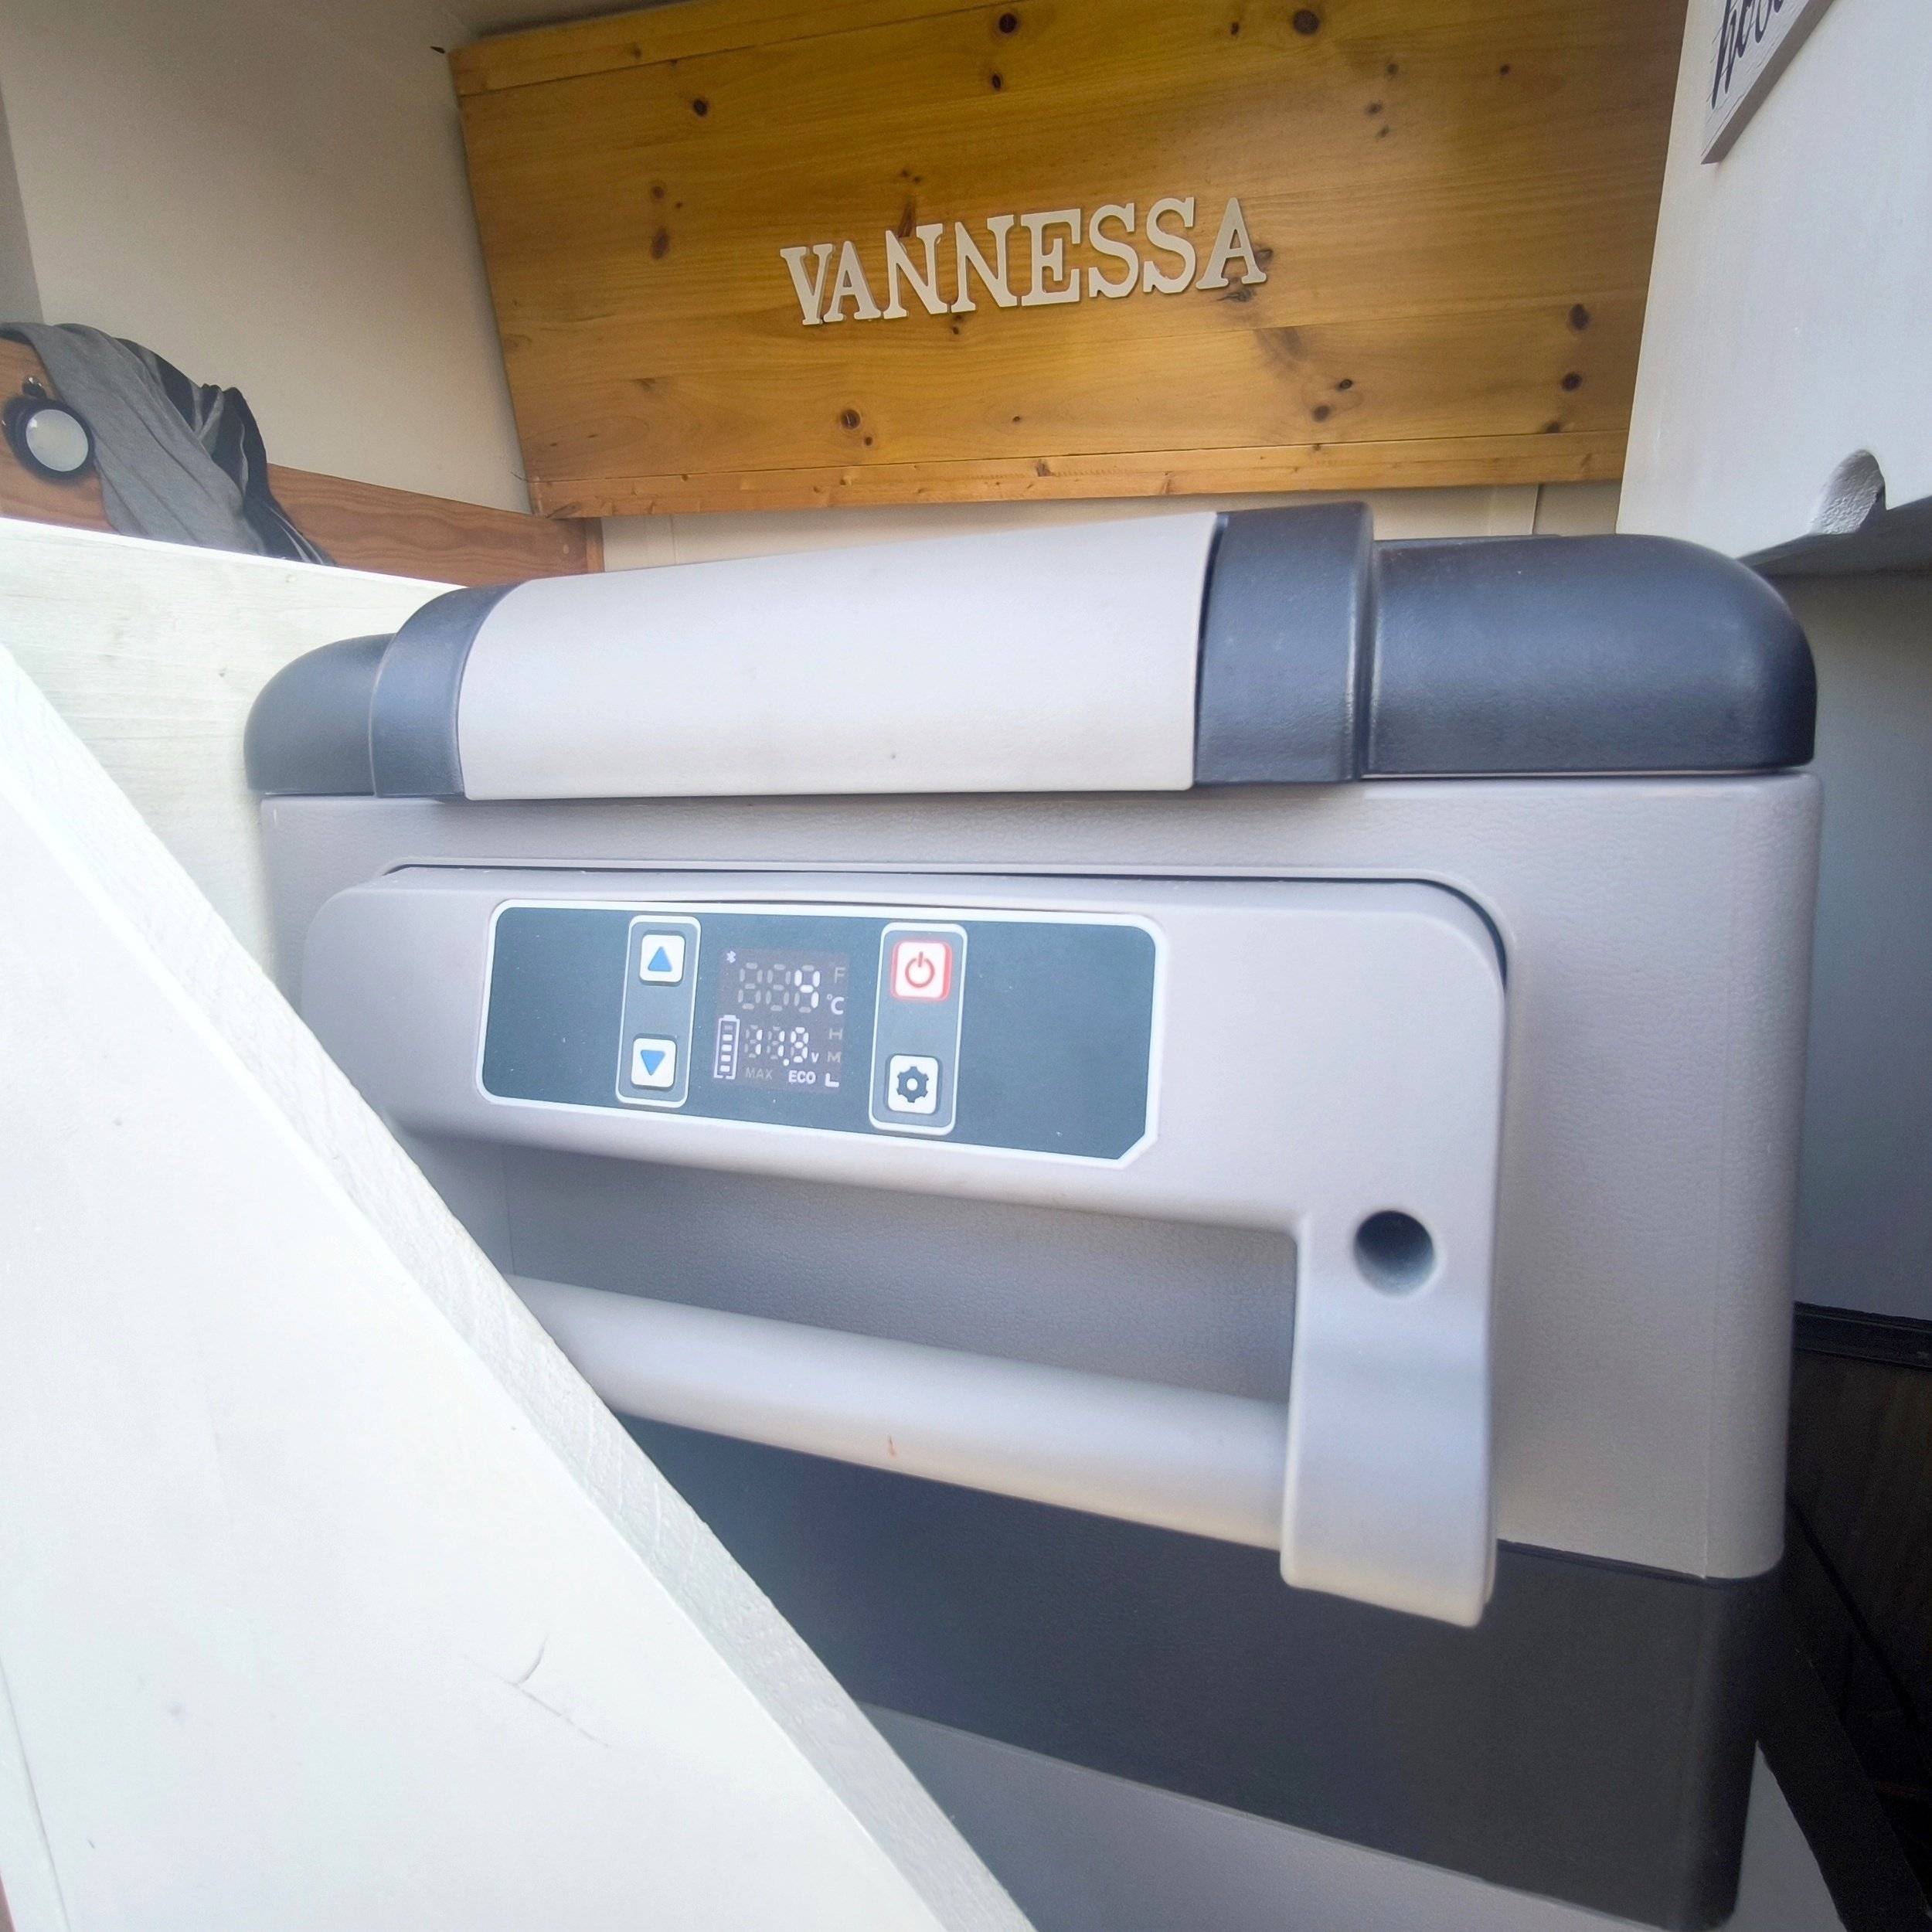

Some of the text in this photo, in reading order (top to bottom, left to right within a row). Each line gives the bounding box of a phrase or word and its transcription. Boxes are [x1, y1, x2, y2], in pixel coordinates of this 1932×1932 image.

[780, 196, 1267, 325] VANNESSA
[745, 1067, 774, 1080] MAX
[788, 1070, 816, 1084] ECO
[825, 1073, 840, 1087] L
